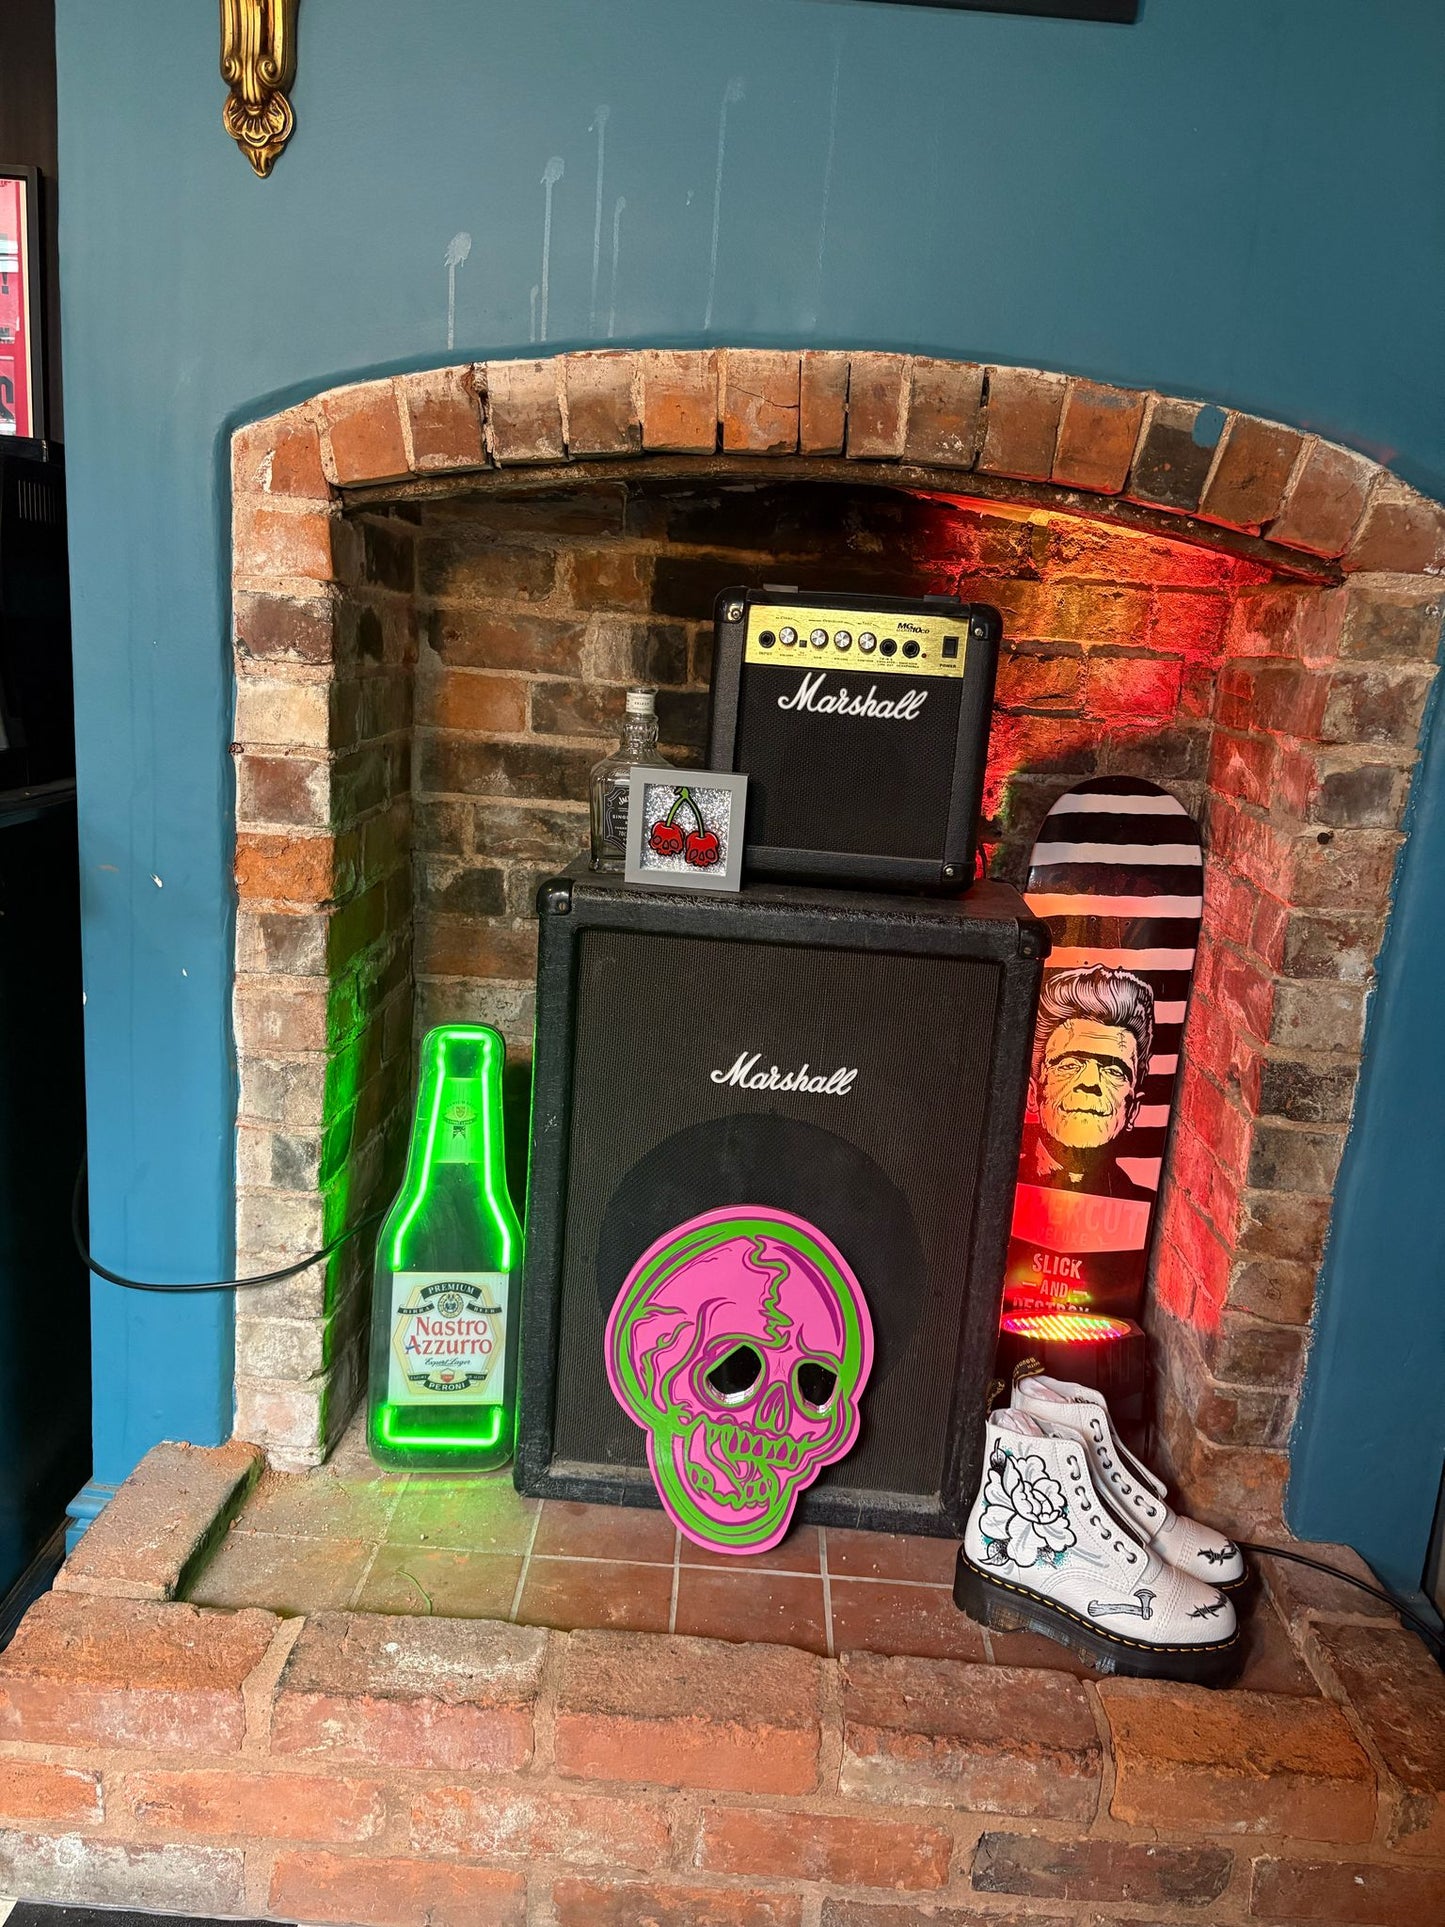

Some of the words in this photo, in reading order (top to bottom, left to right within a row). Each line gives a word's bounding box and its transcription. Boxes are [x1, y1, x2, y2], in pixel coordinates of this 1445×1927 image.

[777, 671, 928, 720] Marshall
[710, 1051, 858, 1095] Marshall
[1032, 1252, 1083, 1279] SLICK
[427, 1282, 475, 1295] PREMIUM
[1040, 1279, 1069, 1298] AND
[416, 1316, 488, 1336] Nastro
[405, 1335, 493, 1355] Azzurro
[428, 1382, 466, 1391] PERONI
